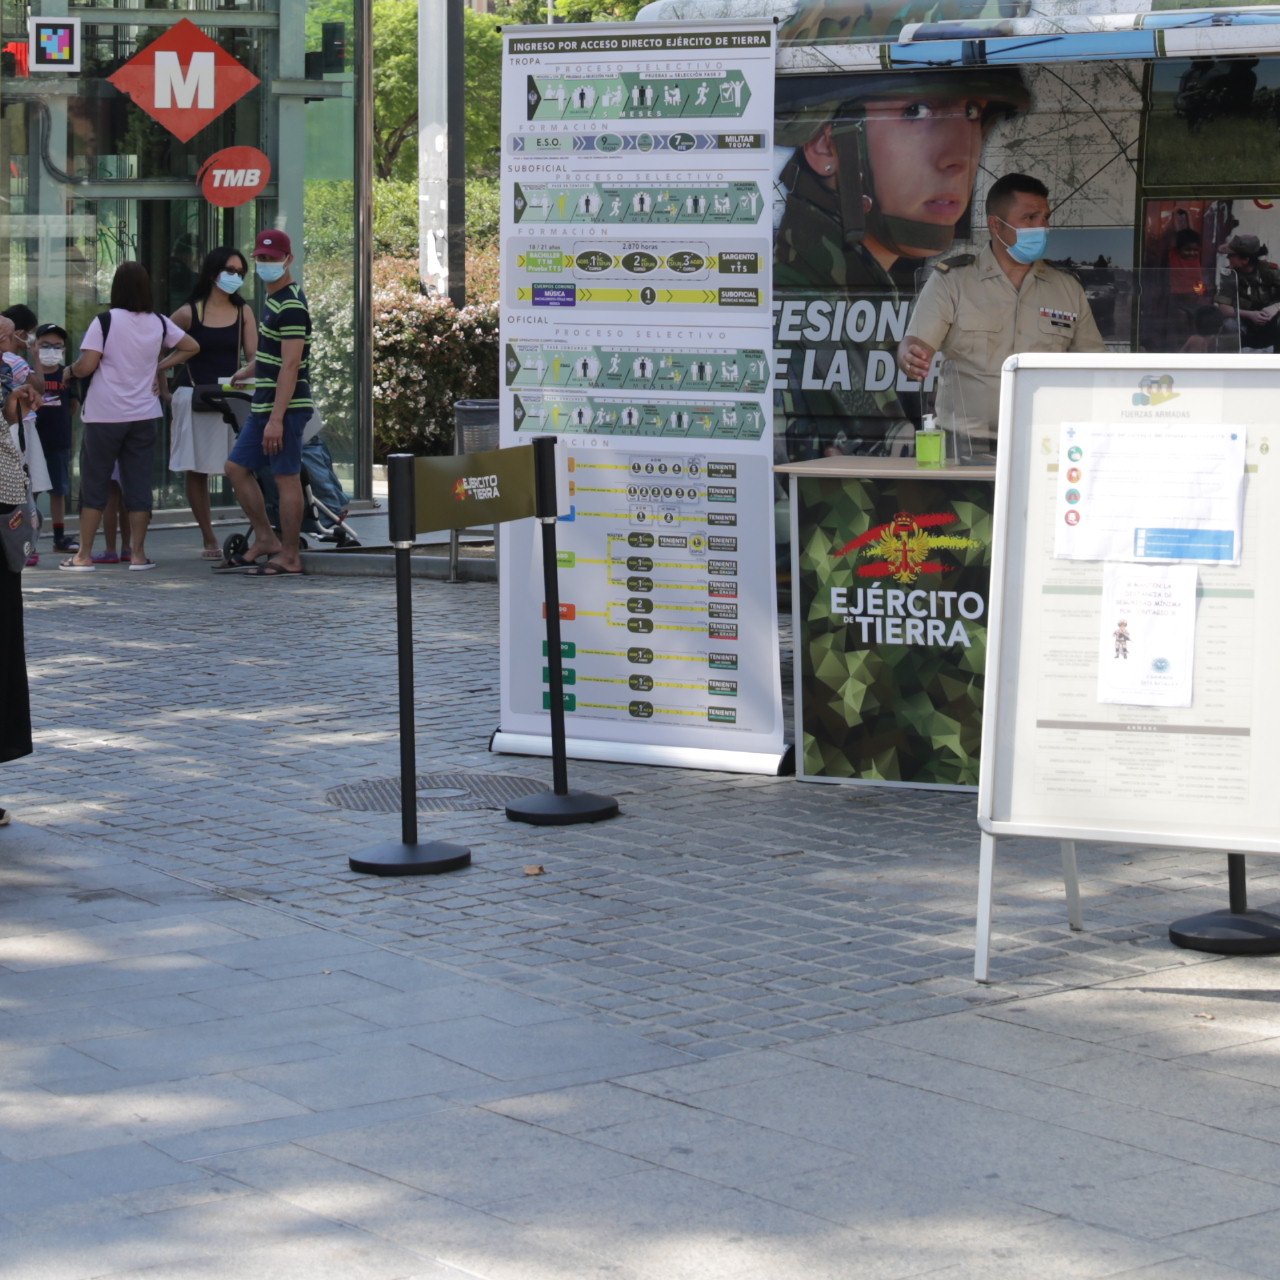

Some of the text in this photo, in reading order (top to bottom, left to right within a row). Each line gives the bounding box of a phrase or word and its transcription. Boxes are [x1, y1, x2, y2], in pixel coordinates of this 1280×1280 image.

[513, 35, 767, 52] INGRESO POR ACCESO DIRECTO EJÉRCITO DE TIERRA
[509, 58, 541, 66] TROPA
[555, 61, 724, 73] PROCESO SELECTIVO
[154, 51, 215, 109] M
[519, 122, 608, 131] FORMACIÓN
[536, 138, 562, 147] E.S.O.
[601, 137, 607, 146] 9
[674, 135, 682, 145] 7
[725, 135, 754, 143] MILITAR
[507, 164, 567, 173] SUBOFICIAL
[212, 169, 261, 188] TMB
[555, 173, 624, 181] PROCESO
[518, 227, 608, 236] FORMACIÓN
[633, 255, 640, 266] 2
[683, 255, 690, 265] 3
[644, 289, 651, 299] 1
[507, 315, 549, 324] OFICIAL
[555, 329, 727, 339] PROCESO SELECTIVO
[801, 349, 852, 391] LA
[1121, 410, 1153, 418] FUERZAS
[472, 486, 500, 500] TIERRA
[659, 536, 686, 544] TENIENTE
[709, 536, 737, 544] TENIENTE
[709, 560, 736, 568] TENIENTE
[830, 581, 985, 620] EJÉRCITO
[843, 616, 971, 648] DE TIERRA
[709, 653, 737, 661] TENIENTE
[709, 680, 737, 688] TENIENTE
